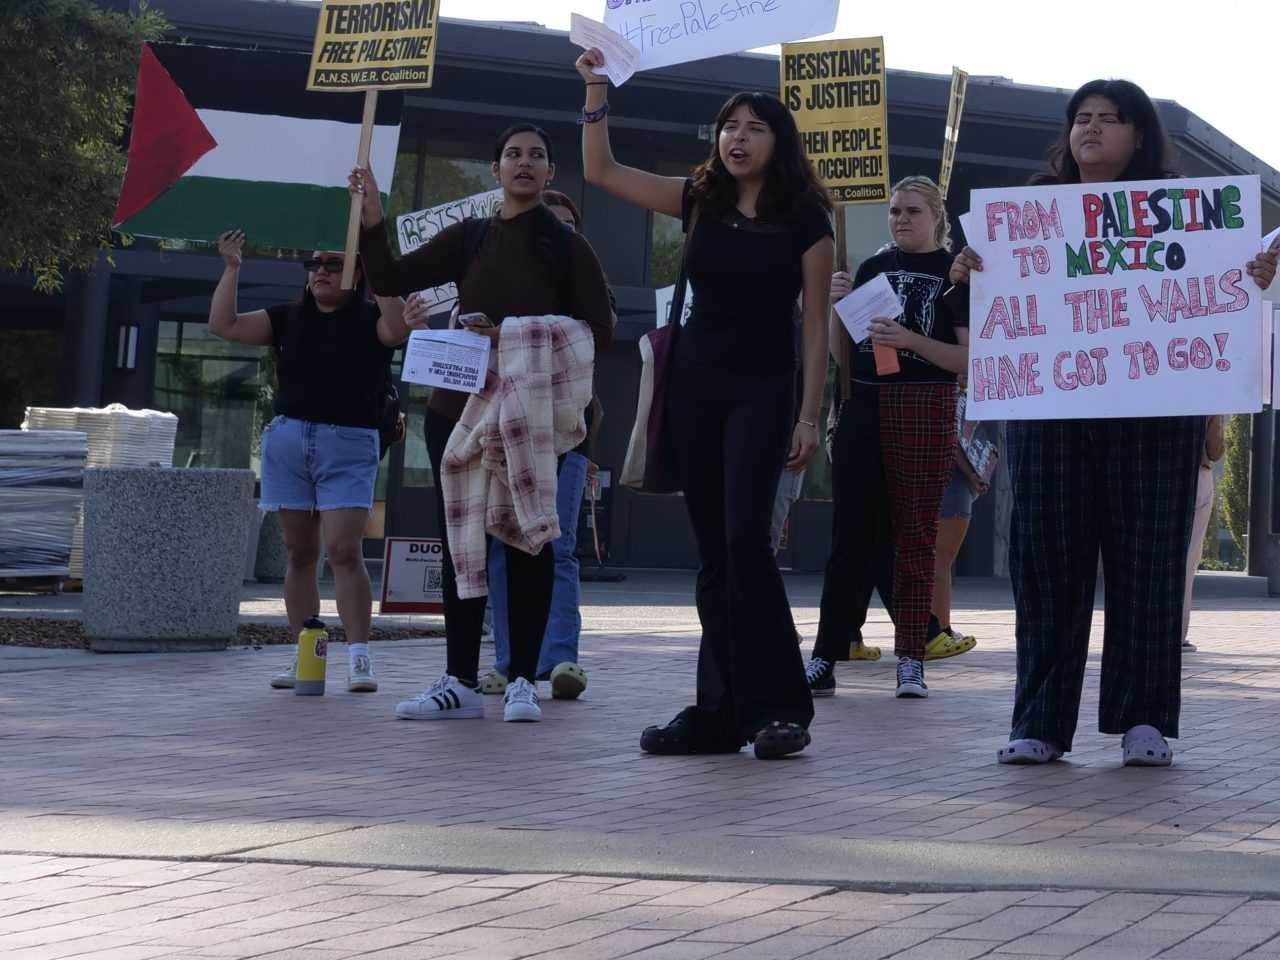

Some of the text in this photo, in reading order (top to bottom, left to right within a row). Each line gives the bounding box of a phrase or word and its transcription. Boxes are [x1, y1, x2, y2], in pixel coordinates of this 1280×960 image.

[318, 36, 432, 64] FREE PALESTINE!
[785, 47, 881, 81] RESISTANCE
[317, 68, 426, 83] A.N.S.W.E.R. Coalition
[785, 79, 881, 111] IS JUSTIFIED
[801, 127, 882, 154] HEN PEOPLE
[818, 155, 883, 179] OCCUPIED!
[844, 188, 884, 198] Coalition
[985, 185, 1244, 241] FROM PALESTINE
[1012, 239, 1186, 278] TO MEXICO
[980, 269, 1250, 339] ALL THE WALLS
[972, 332, 1231, 402] HAVE GOT TO GO!
